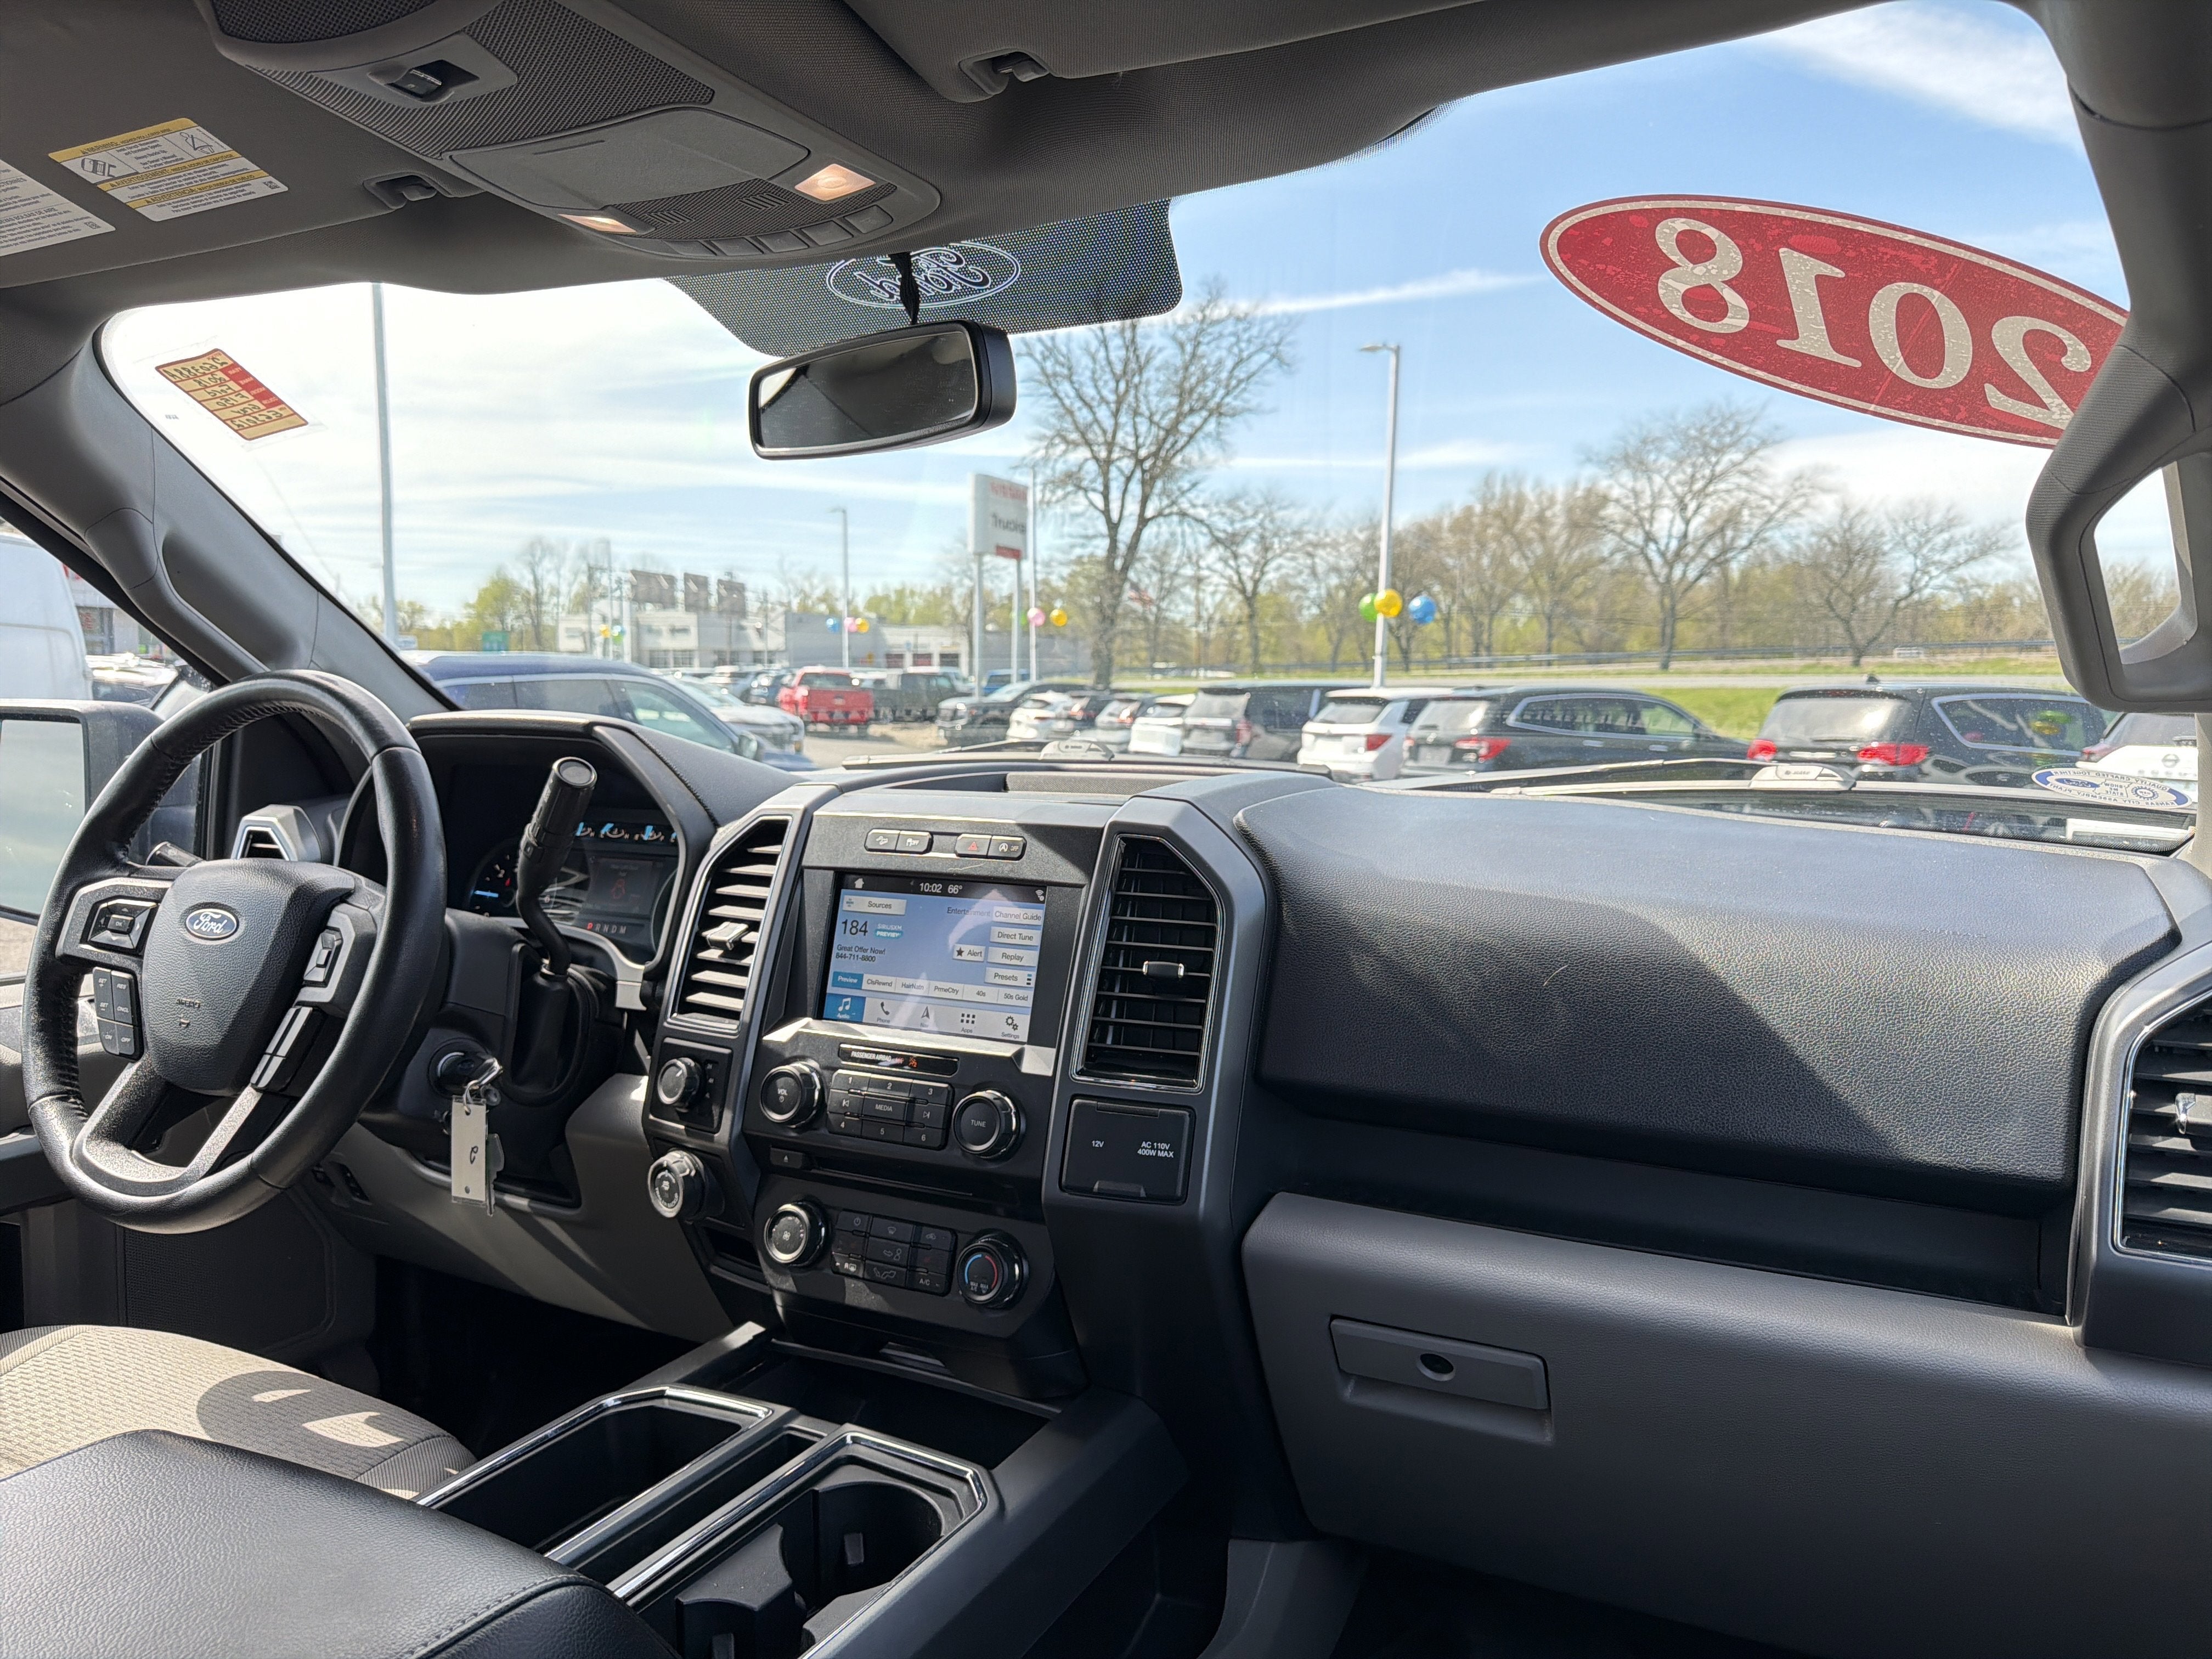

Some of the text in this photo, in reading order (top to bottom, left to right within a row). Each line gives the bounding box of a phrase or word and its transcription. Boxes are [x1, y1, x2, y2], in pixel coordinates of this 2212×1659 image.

[919, 882, 963, 894] 10:02 66°
[868, 901, 892, 909] Sources
[995, 910, 1042, 921] Channel Guide
[193, 911, 228, 934] Ford
[842, 918, 868, 936] 184
[997, 931, 1017, 939] Direct
[854, 945, 868, 953] Offer
[870, 947, 886, 955] Now!
[967, 949, 983, 957] Alert
[836, 952, 876, 962] 844-711-8800
[1002, 952, 1024, 962] Replay
[838, 975, 858, 984] Preview
[994, 972, 1018, 981] Presets
[867, 978, 893, 987] ClsRewnd
[901, 982, 924, 990] HairNatn
[934, 985, 960, 995] PrmeCtry
[851, 1051, 876, 1060] PASSENGER
[876, 1053, 891, 1062] AIRBAG
[777, 1088, 788, 1096] VOL
[928, 1087, 933, 1096] 3
[875, 1104, 893, 1112] MEDIA
[970, 1119, 986, 1128] TUNE
[1137, 1148, 1156, 1157] 400W
[919, 1278, 930, 1286] A/C
